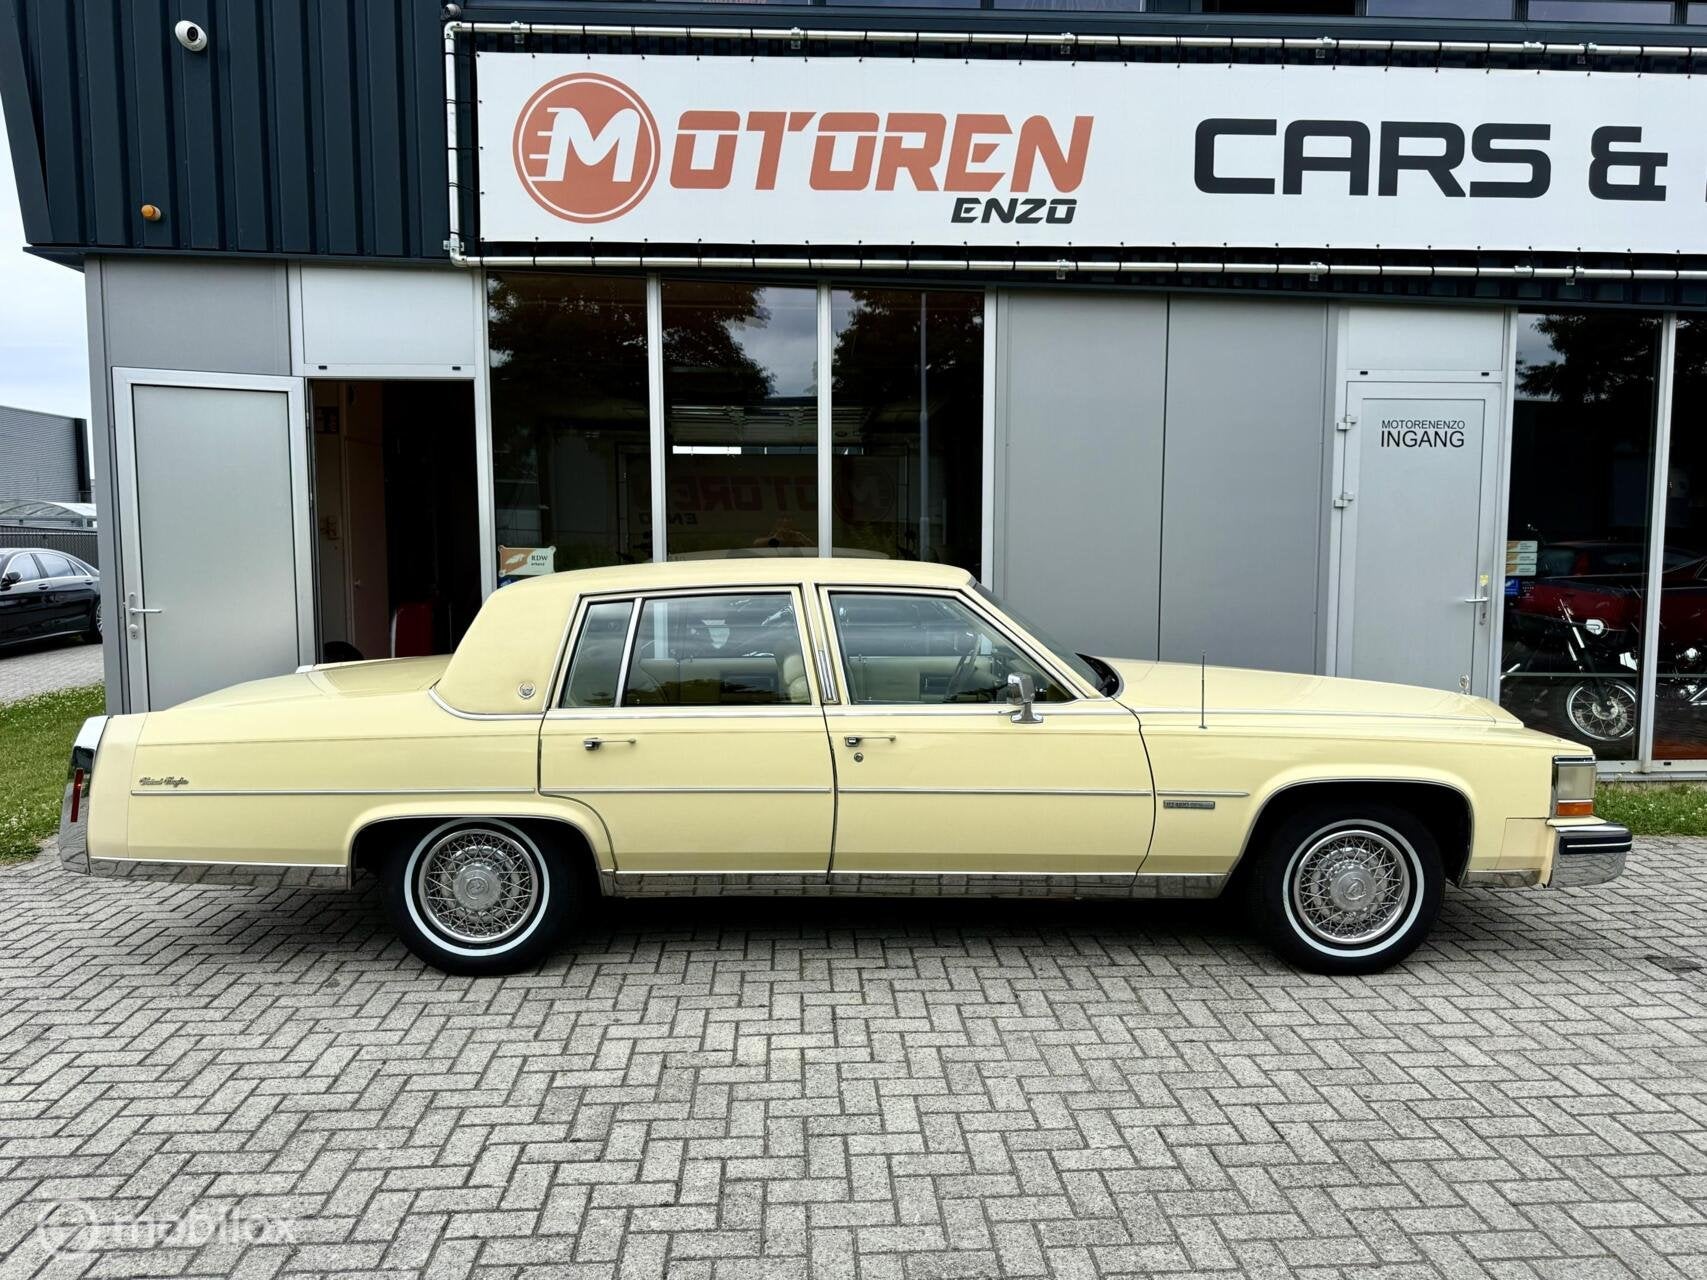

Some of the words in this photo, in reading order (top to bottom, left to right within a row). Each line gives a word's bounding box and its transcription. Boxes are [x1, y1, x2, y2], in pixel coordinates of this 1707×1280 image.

[1194, 117, 1551, 199] CARS
[1588, 125, 1669, 202] &
[951, 197, 1078, 225] ENZO
[1381, 420, 1466, 430] MOTORENENZO
[1381, 430, 1465, 448] INGANG
